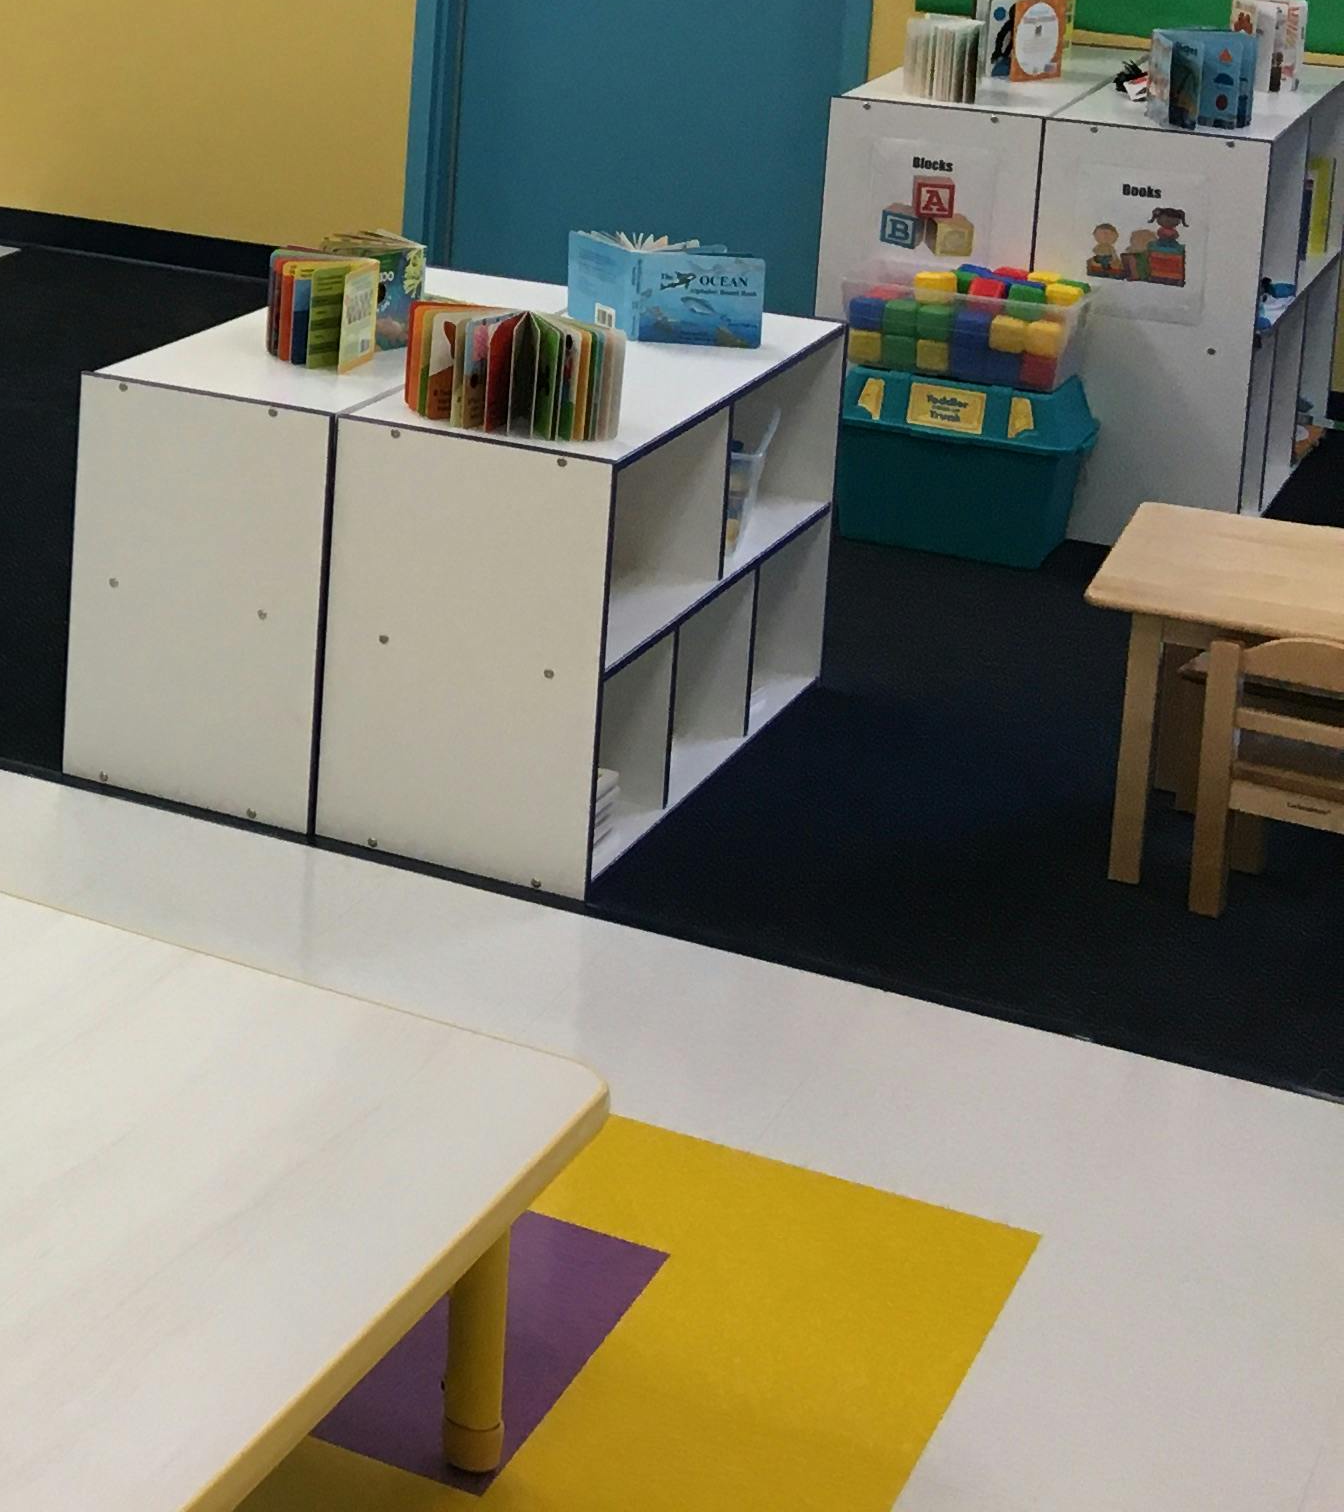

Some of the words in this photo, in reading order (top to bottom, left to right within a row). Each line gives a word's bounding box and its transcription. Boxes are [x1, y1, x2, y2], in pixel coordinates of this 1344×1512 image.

[912, 155, 954, 173] Blocks
[1122, 183, 1162, 199] Books
[924, 190, 948, 212] A
[889, 219, 910, 241] B
[698, 276, 749, 288] OCEAN
